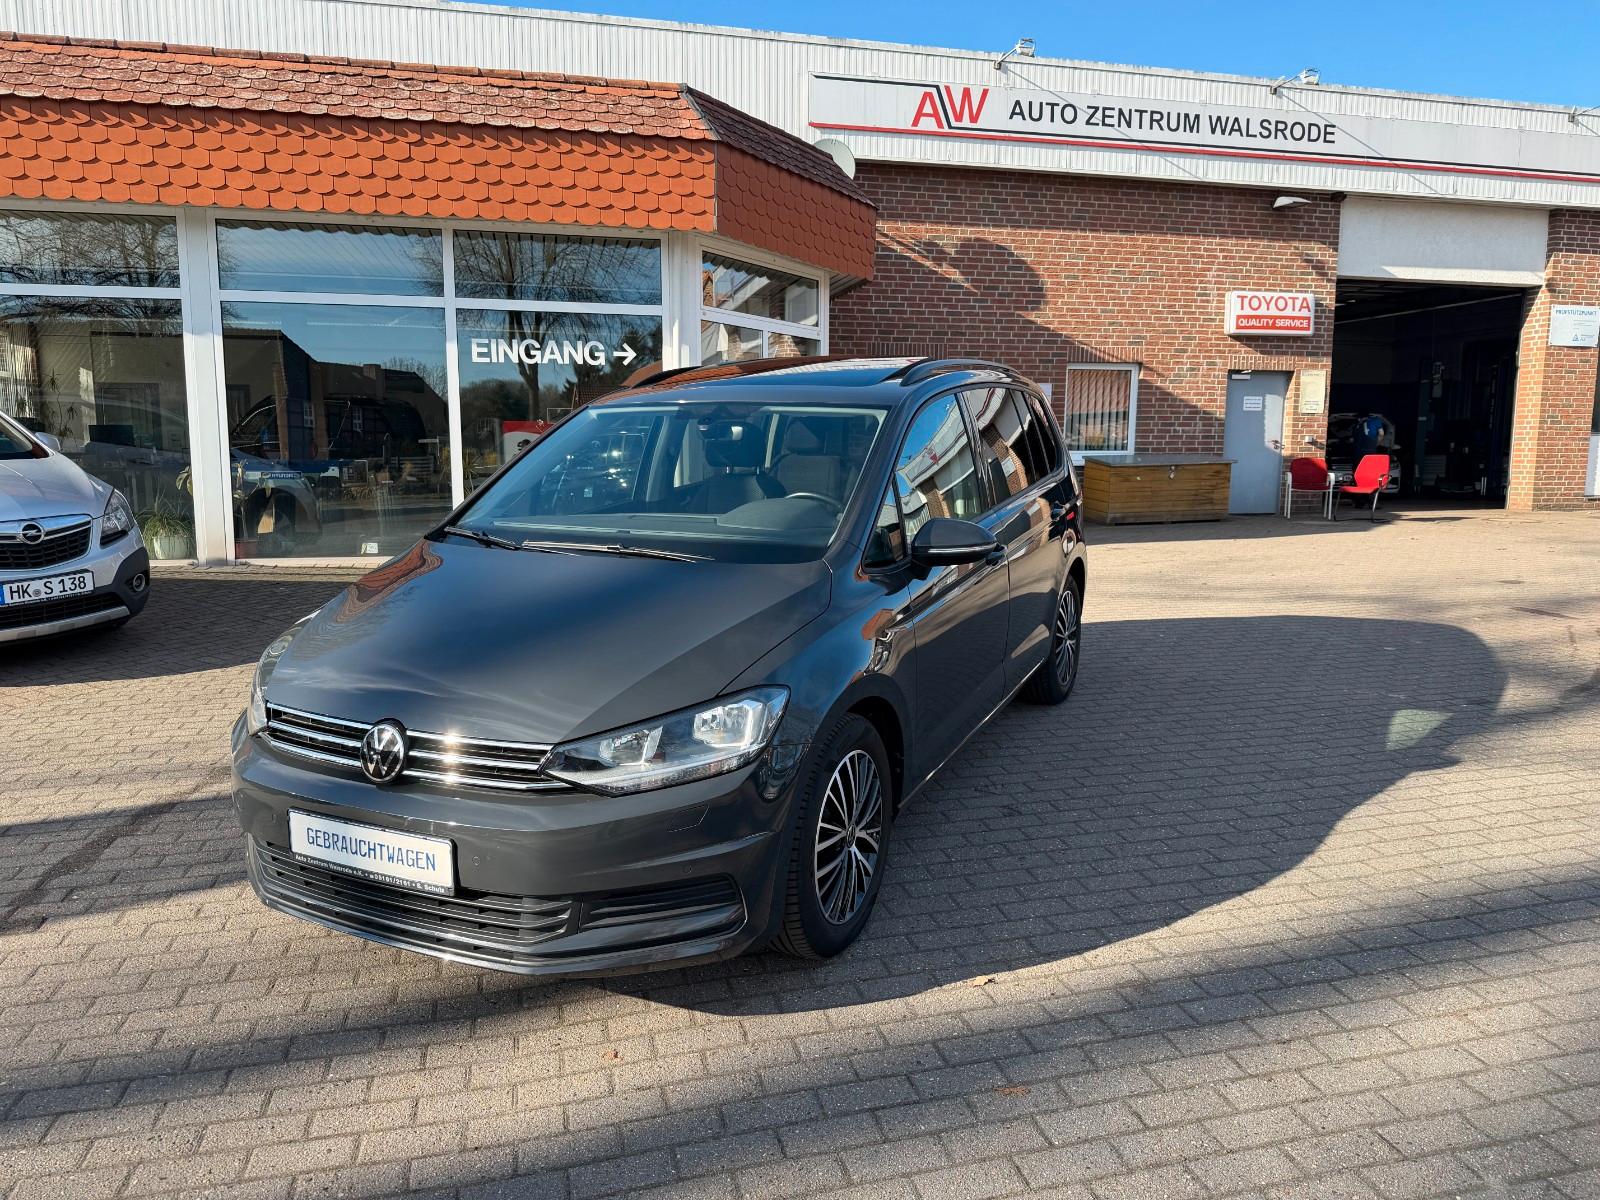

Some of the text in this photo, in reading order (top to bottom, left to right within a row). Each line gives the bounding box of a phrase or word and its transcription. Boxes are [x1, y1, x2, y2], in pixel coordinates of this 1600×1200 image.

[1008, 99, 1337, 145] AUTO ZENTRUM WALSRODE
[1236, 295, 1312, 313] TOYOTA
[1238, 318, 1309, 328] QUALITY SERVICE
[470, 337, 607, 367] EINGANG
[9, 583, 33, 600] HK
[43, 580, 54, 595] S
[58, 575, 87, 593] 138
[306, 827, 436, 872] GEBRAUCHTWAGEN
